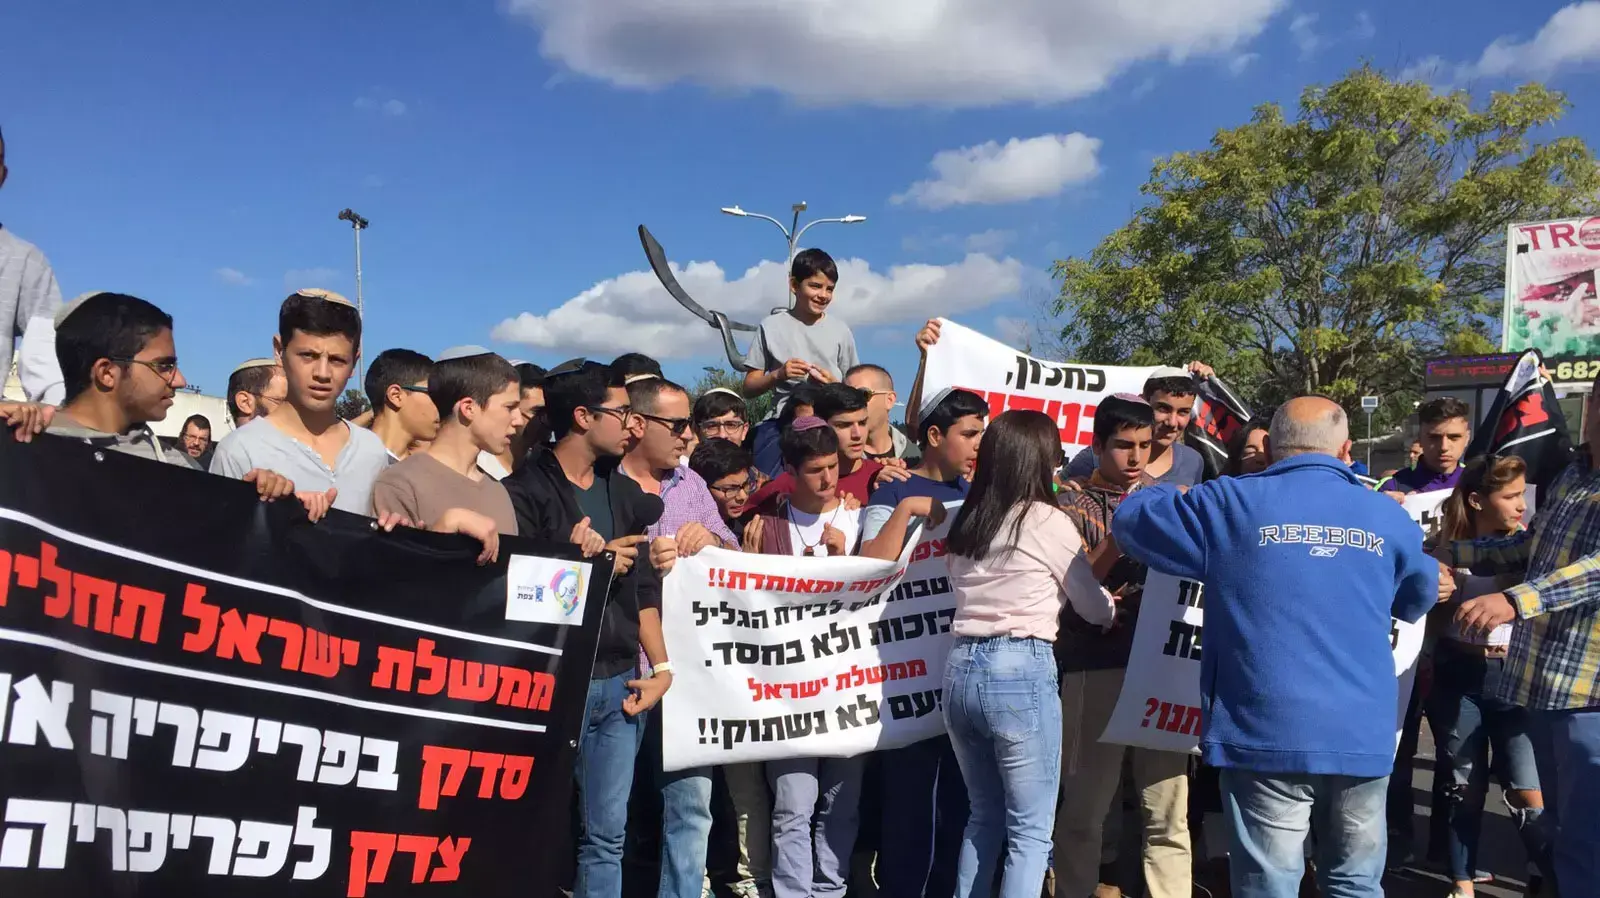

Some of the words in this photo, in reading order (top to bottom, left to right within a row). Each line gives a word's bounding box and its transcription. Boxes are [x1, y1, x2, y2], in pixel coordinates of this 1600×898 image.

[1005, 355, 1106, 393] כחלון,
[1259, 525, 1384, 557] REEBOK
[182, 584, 360, 678] ישראל
[692, 601, 769, 629] הגליל
[704, 639, 806, 668] בחסד.
[810, 622, 862, 659] ולא
[371, 639, 556, 711] ממשלת
[747, 677, 830, 702] ישראל
[836, 658, 928, 692] ממשלת
[697, 709, 830, 751] נשתוק!!
[834, 693, 881, 731] לא
[91, 689, 399, 791] בפריפריה
[419, 745, 535, 811] סדק
[0, 798, 333, 880] לפריפריה
[347, 830, 472, 898] צדק
